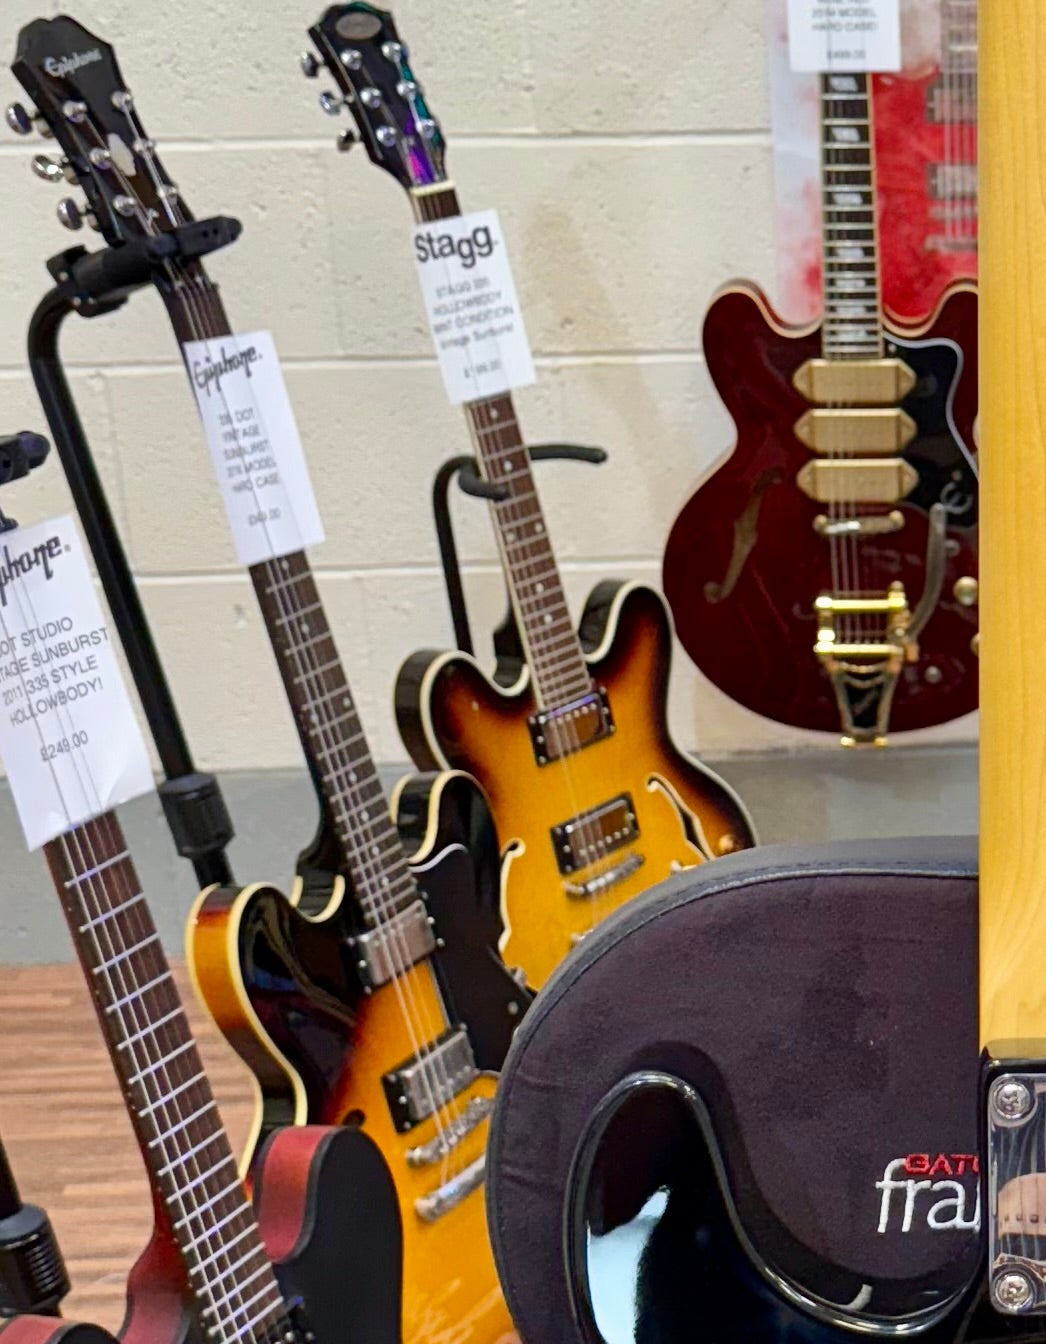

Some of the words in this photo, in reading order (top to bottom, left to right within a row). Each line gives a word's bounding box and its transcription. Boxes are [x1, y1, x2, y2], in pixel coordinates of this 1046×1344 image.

[44, 48, 102, 78] Epiphone
[415, 225, 494, 268] Stagg
[193, 345, 258, 397] Epiphone
[0, 536, 62, 607] phone
[0, 636, 17, 656] OT
[20, 616, 73, 647] STUDIO
[0, 656, 30, 681] TAGE
[32, 627, 108, 667] SUNBURST
[27, 674, 50, 696] 335
[52, 654, 98, 685] STYLE
[9, 677, 104, 728] HOLLOWBODY!
[876, 1158, 980, 1234] fra
